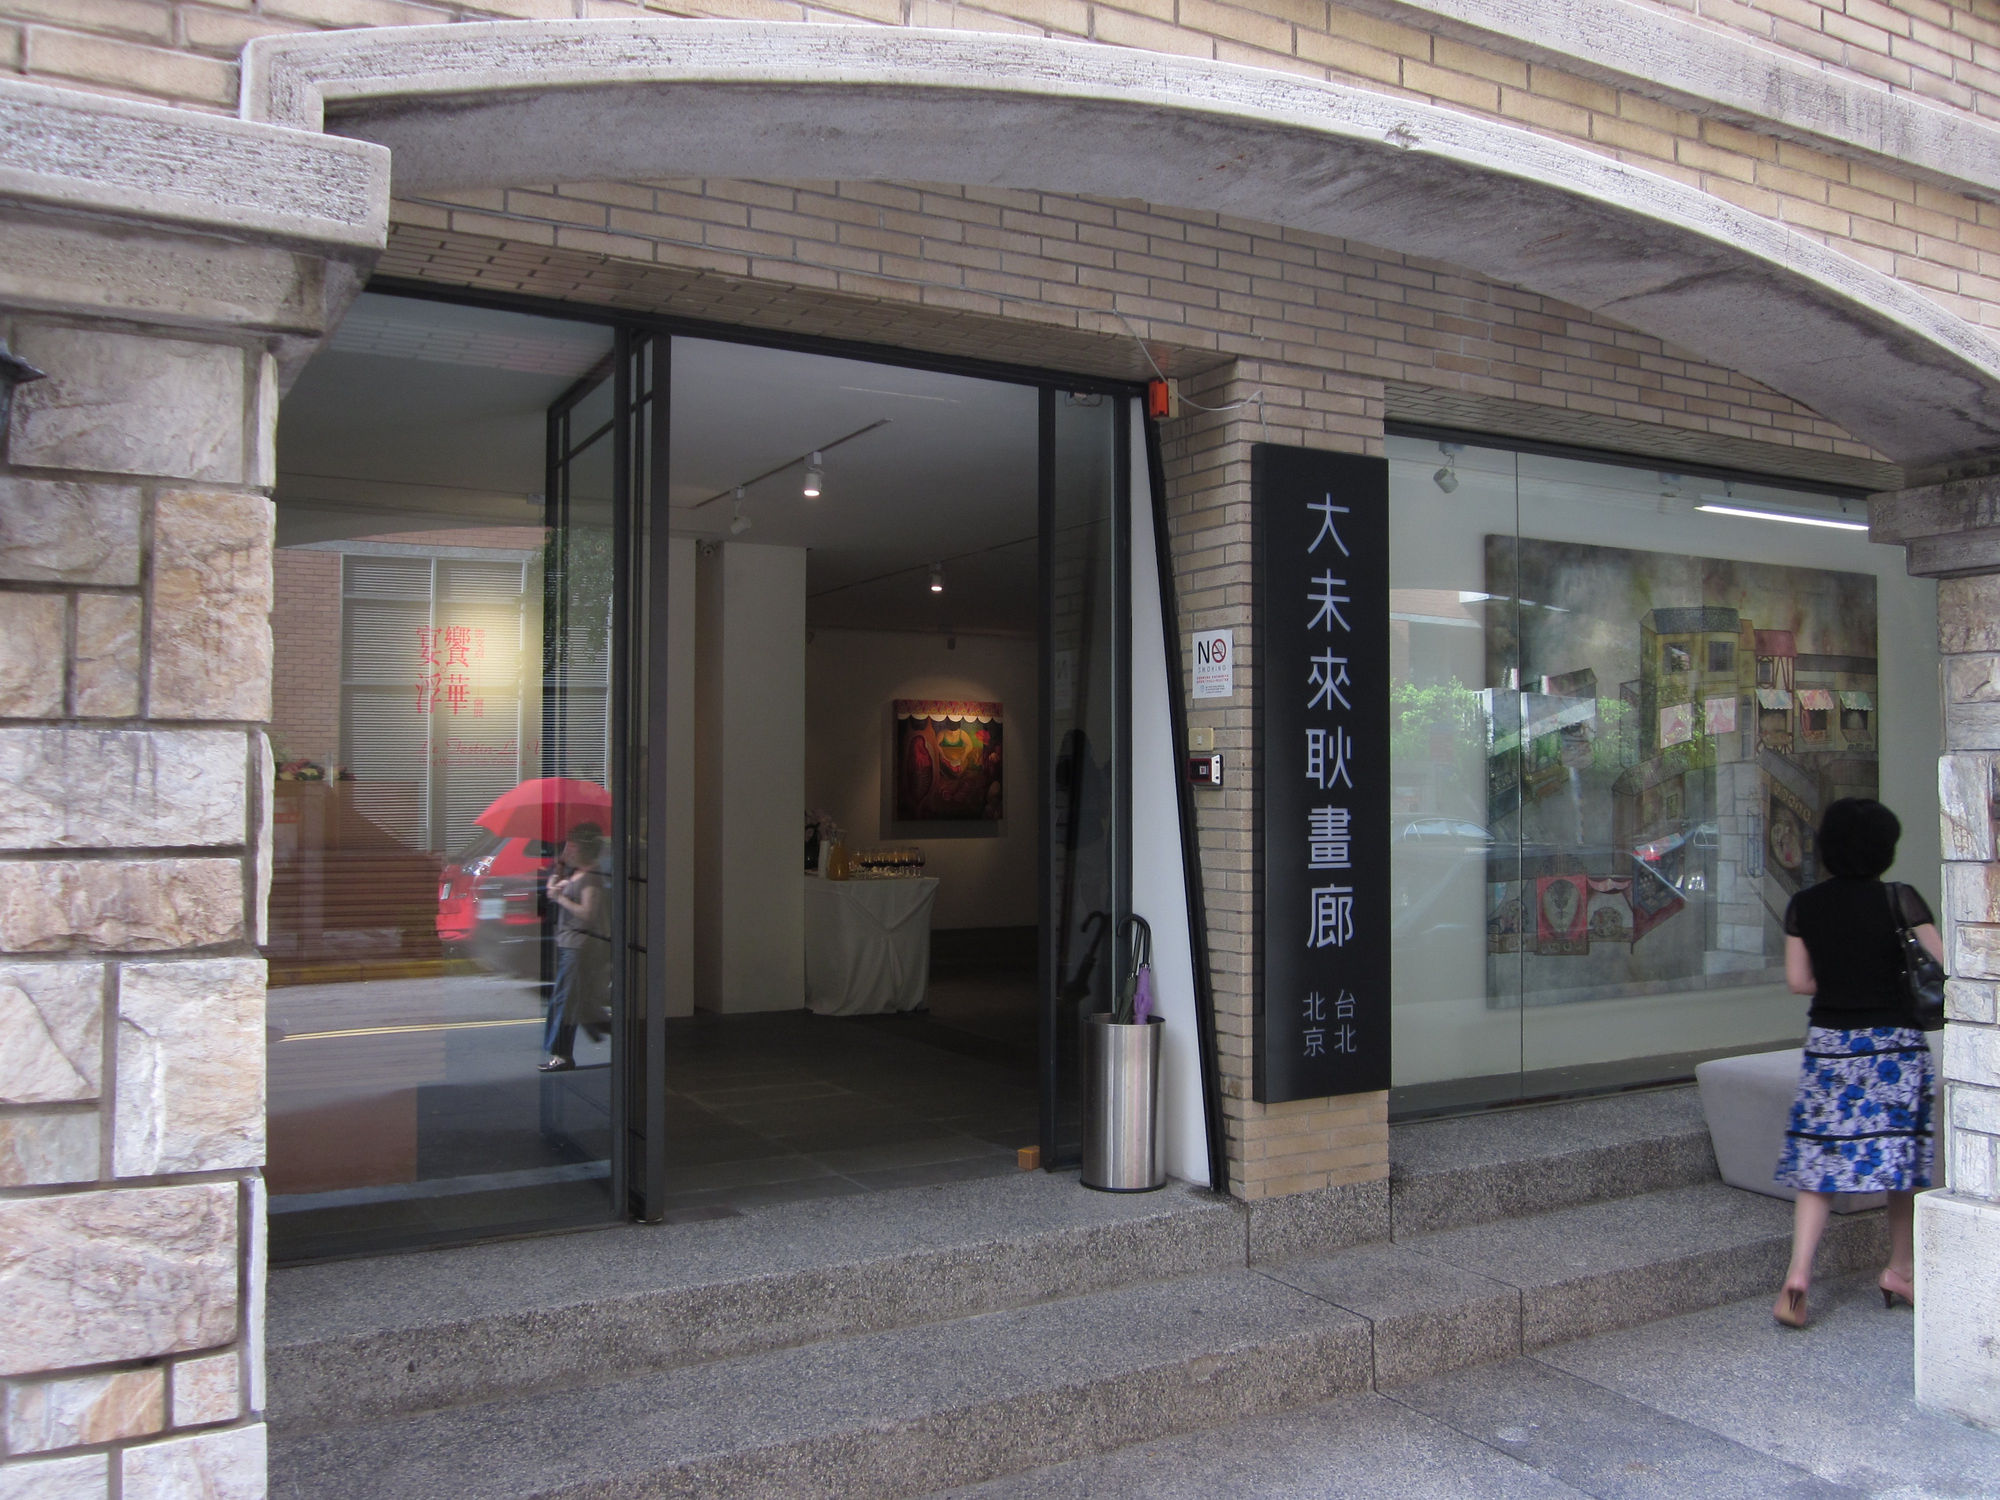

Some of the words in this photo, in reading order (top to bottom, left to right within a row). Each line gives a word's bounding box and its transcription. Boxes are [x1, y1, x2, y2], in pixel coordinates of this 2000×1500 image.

[1305, 492, 1354, 949] 大未來耿畫廊
[1302, 991, 1327, 1057] 北京
[1334, 988, 1357, 1054] 台北
